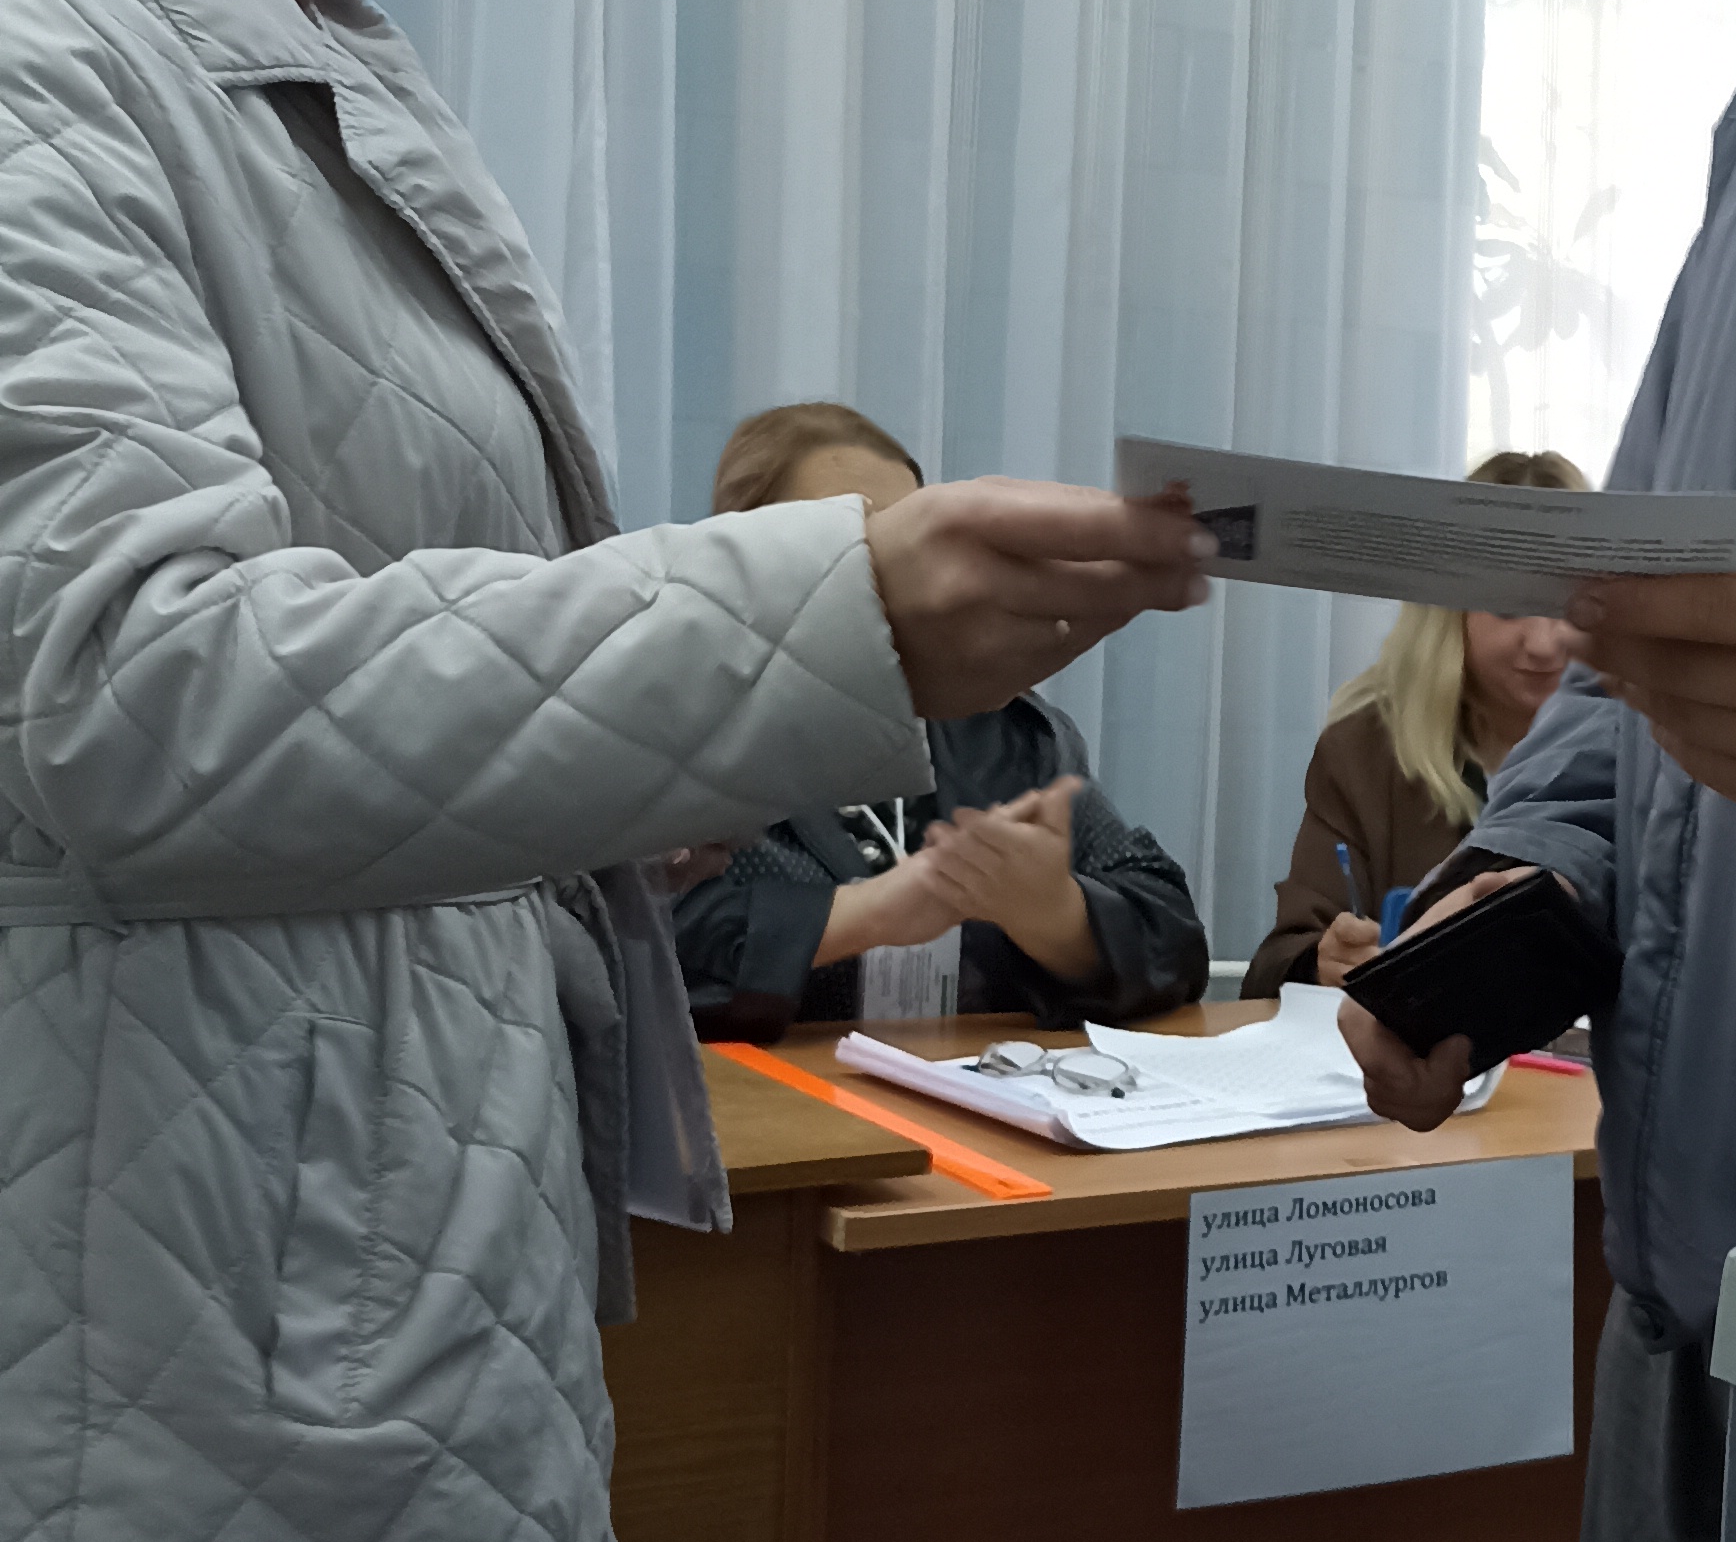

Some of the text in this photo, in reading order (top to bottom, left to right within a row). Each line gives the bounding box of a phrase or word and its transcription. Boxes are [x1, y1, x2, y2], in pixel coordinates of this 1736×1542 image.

[1201, 1187, 1437, 1238] улица Ломоносова
[1200, 1236, 1387, 1281] улица Луговая
[1199, 1270, 1449, 1324] улица Металлургов
